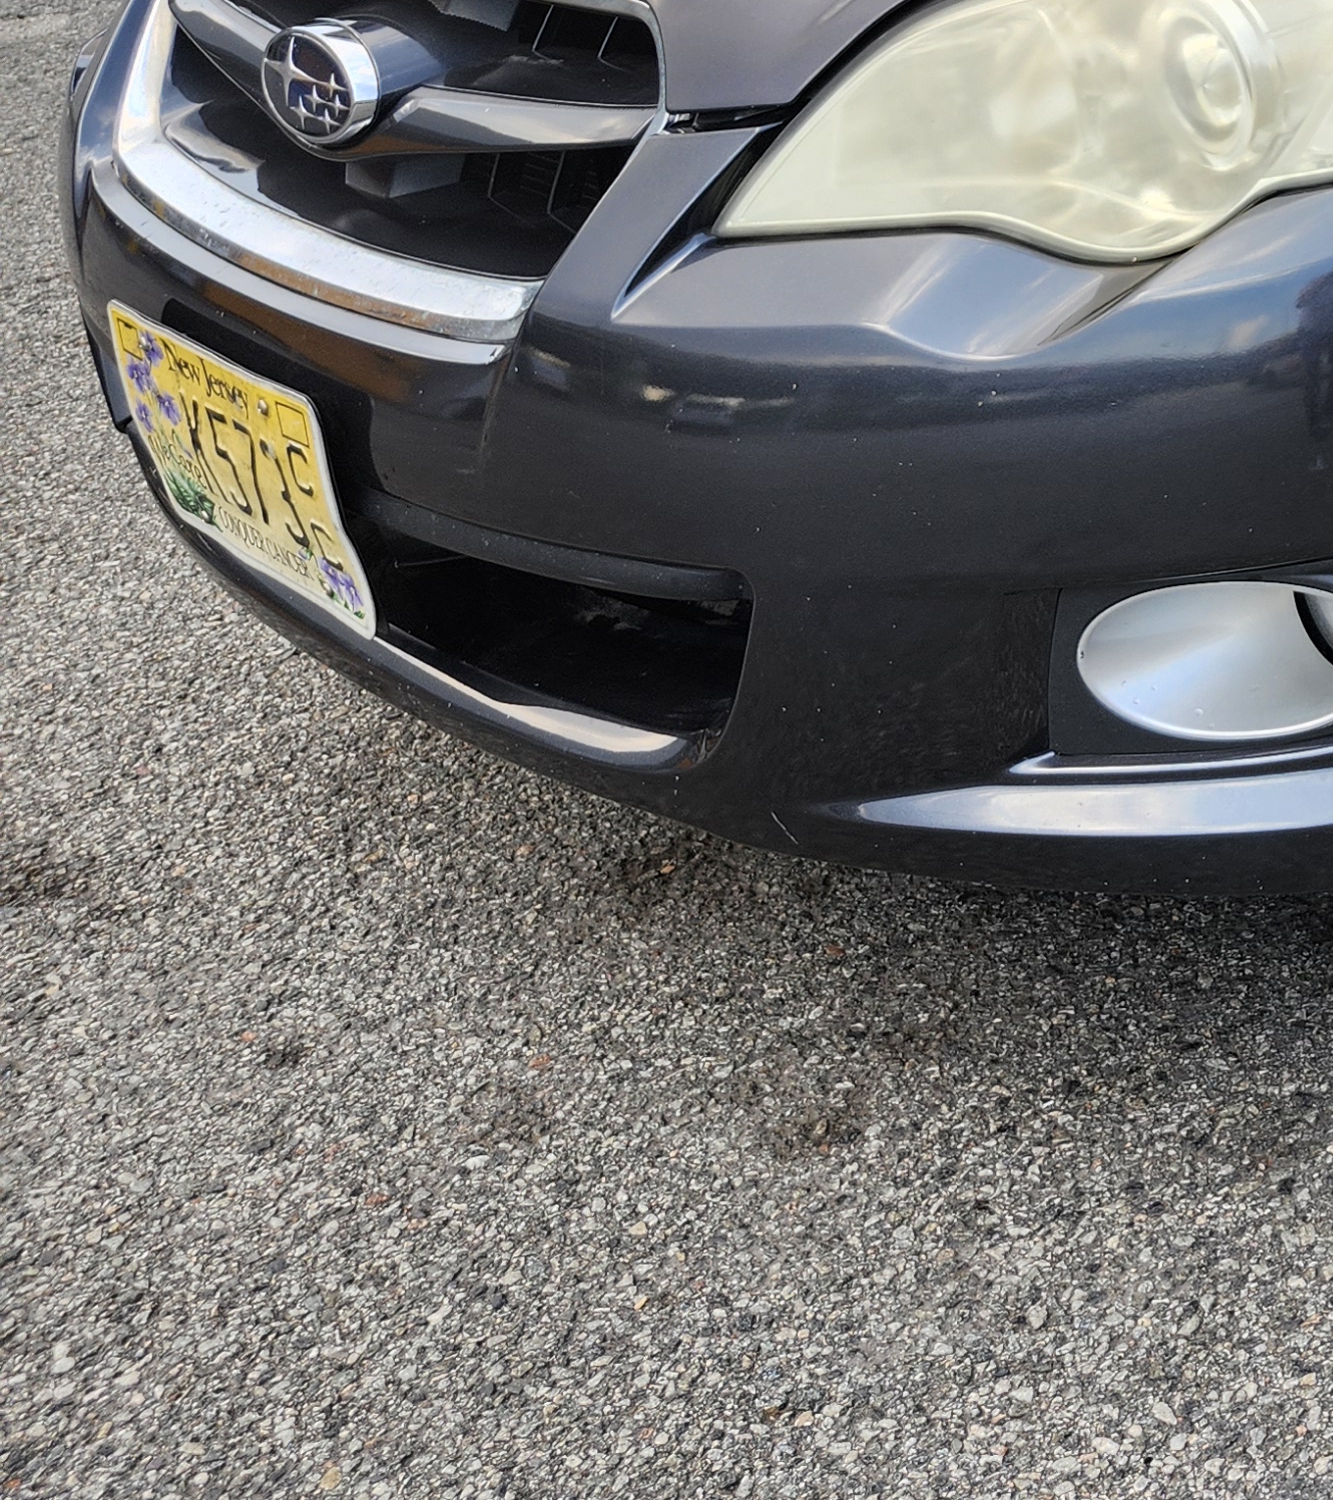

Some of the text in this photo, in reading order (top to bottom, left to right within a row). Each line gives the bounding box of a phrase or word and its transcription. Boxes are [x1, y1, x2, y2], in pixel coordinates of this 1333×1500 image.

[161, 338, 249, 420] New Jersey
[218, 505, 313, 581] CONQUER CANCER
